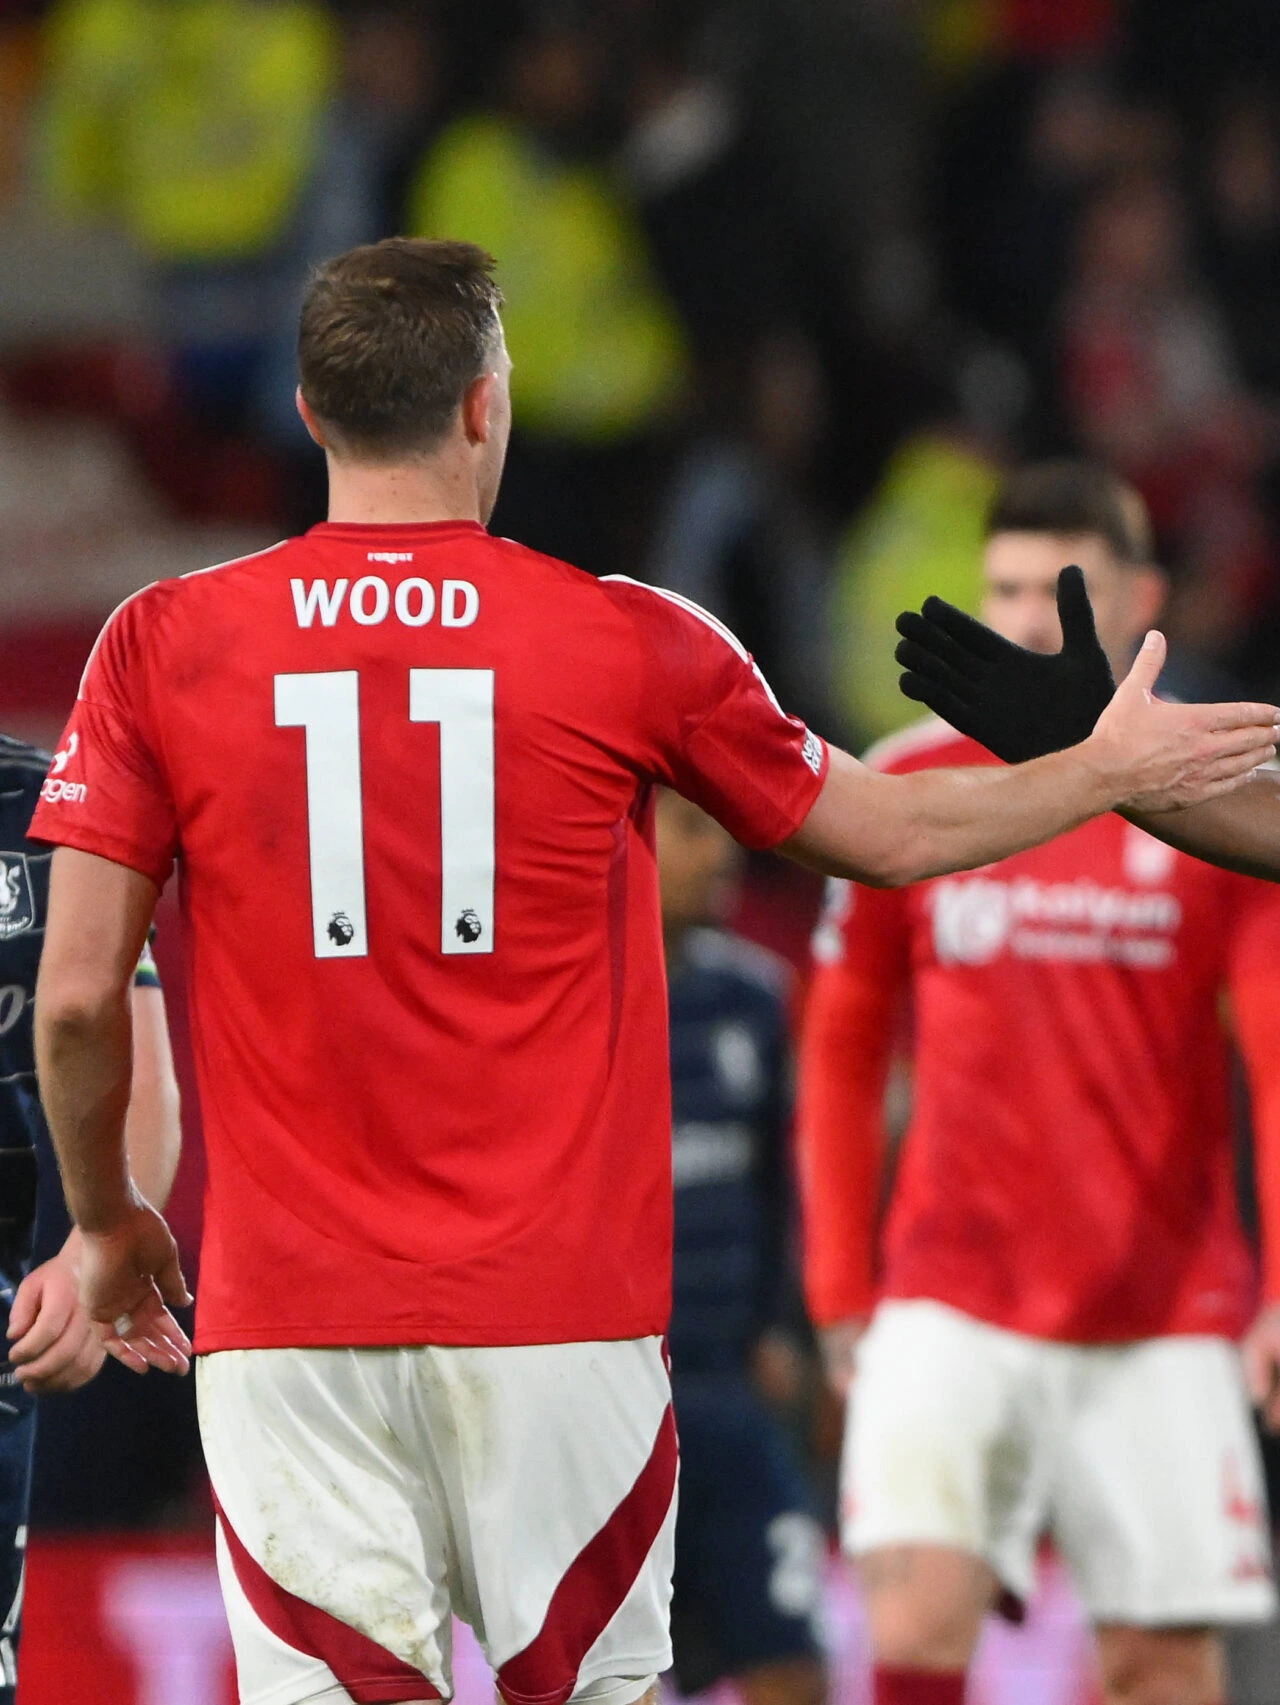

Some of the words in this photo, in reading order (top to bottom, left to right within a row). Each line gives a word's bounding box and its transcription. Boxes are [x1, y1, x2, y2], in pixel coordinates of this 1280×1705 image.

[290, 575, 480, 628] WOOD
[40, 778, 88, 803] agen
[273, 667, 496, 958] 11
